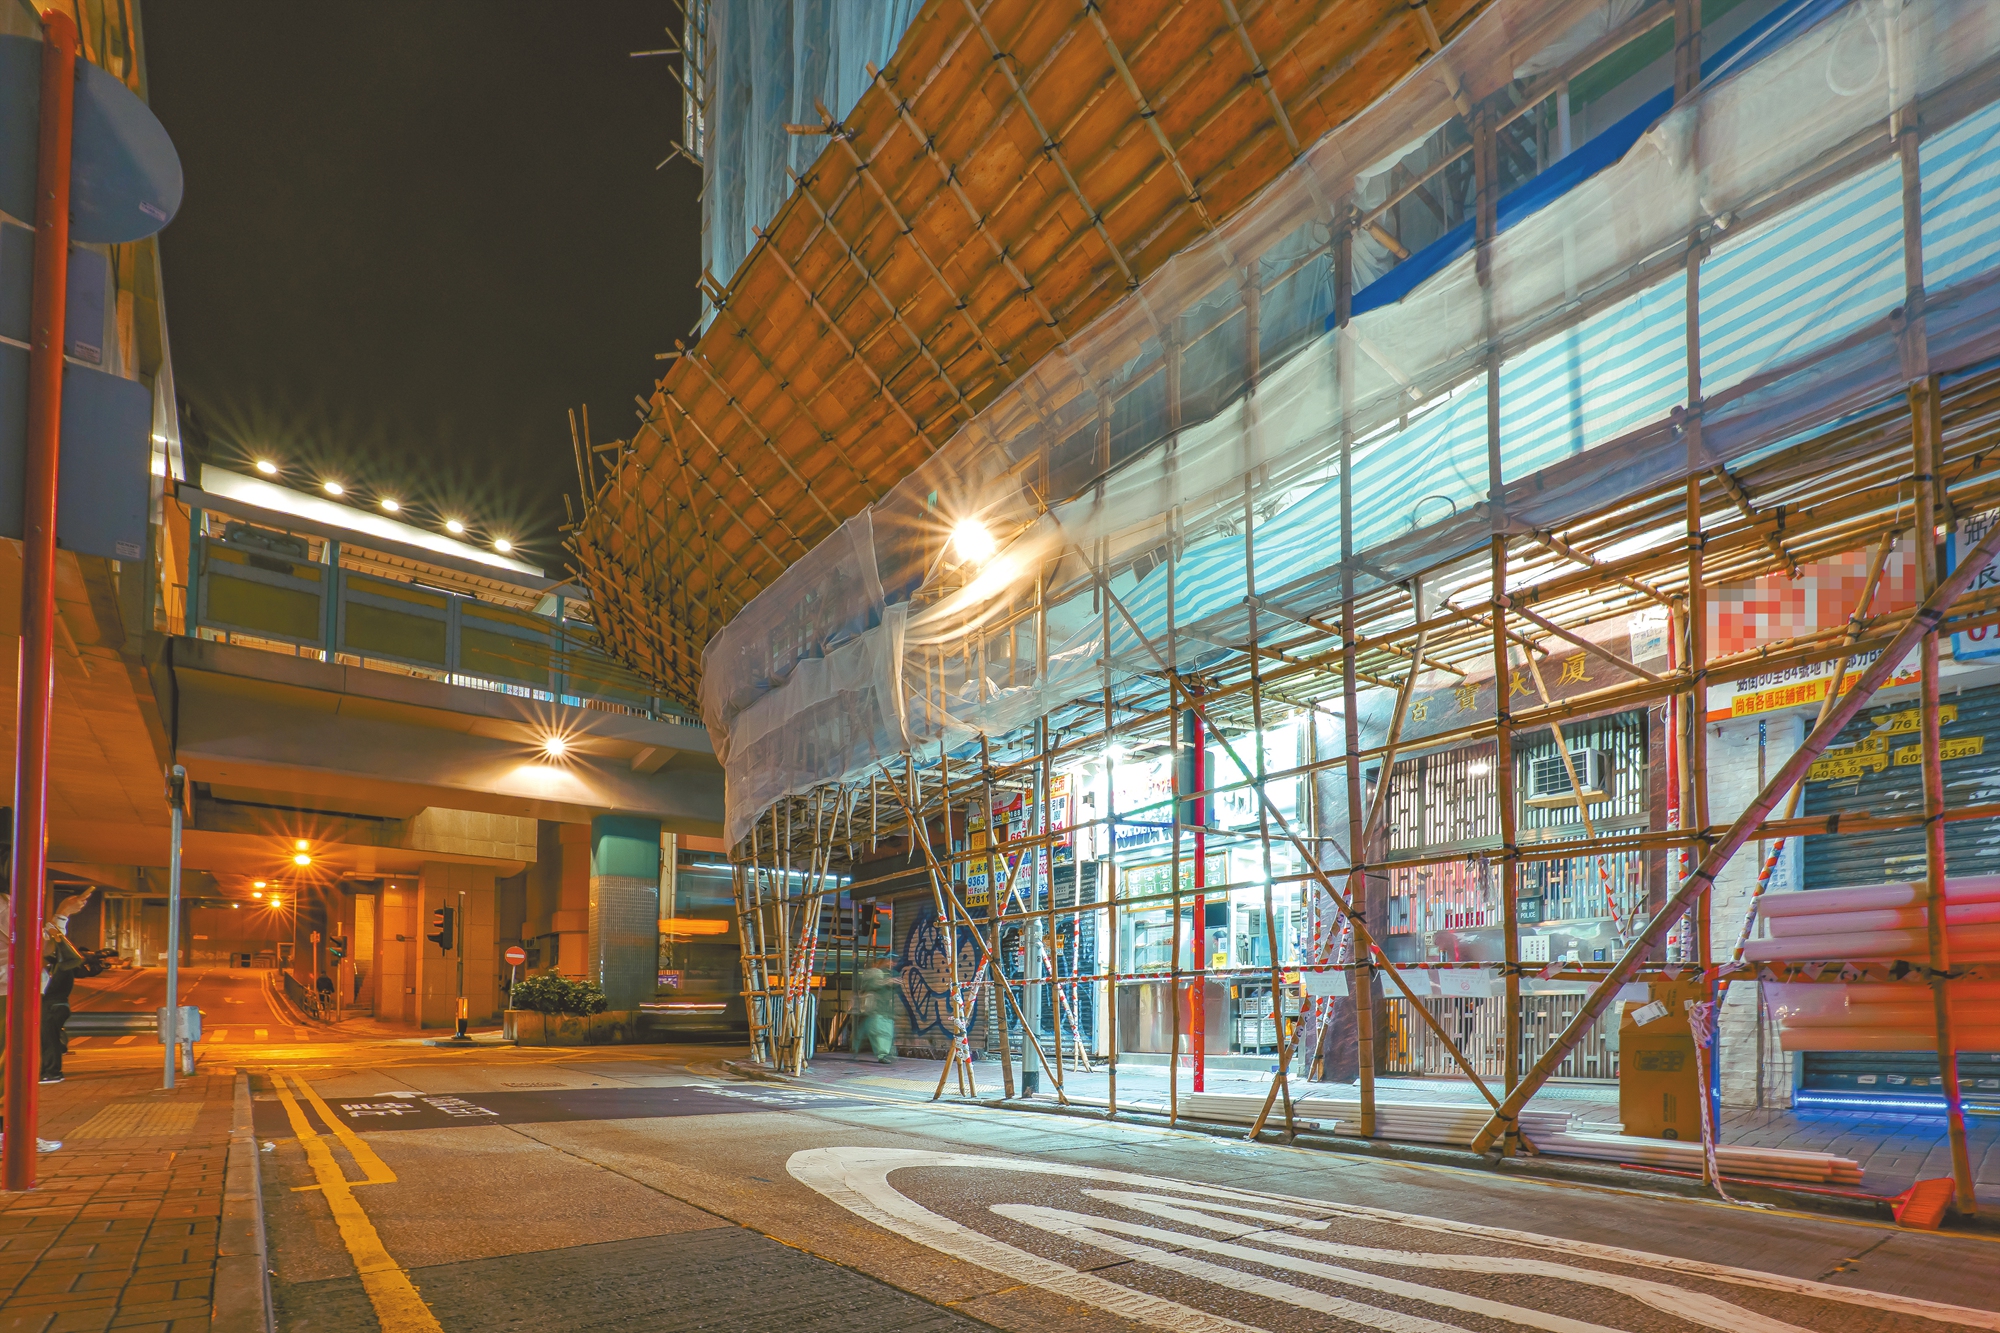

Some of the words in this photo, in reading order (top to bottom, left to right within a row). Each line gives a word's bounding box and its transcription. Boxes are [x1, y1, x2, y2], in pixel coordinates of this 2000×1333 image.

[1408, 651, 1594, 723] 百寶大廈
[1940, 746, 1977, 759] 6349
[1813, 768, 1845, 780] 6059
[968, 875, 986, 887] 9363
[967, 892, 1004, 905] 2781132
[1521, 901, 1536, 911] 警察
